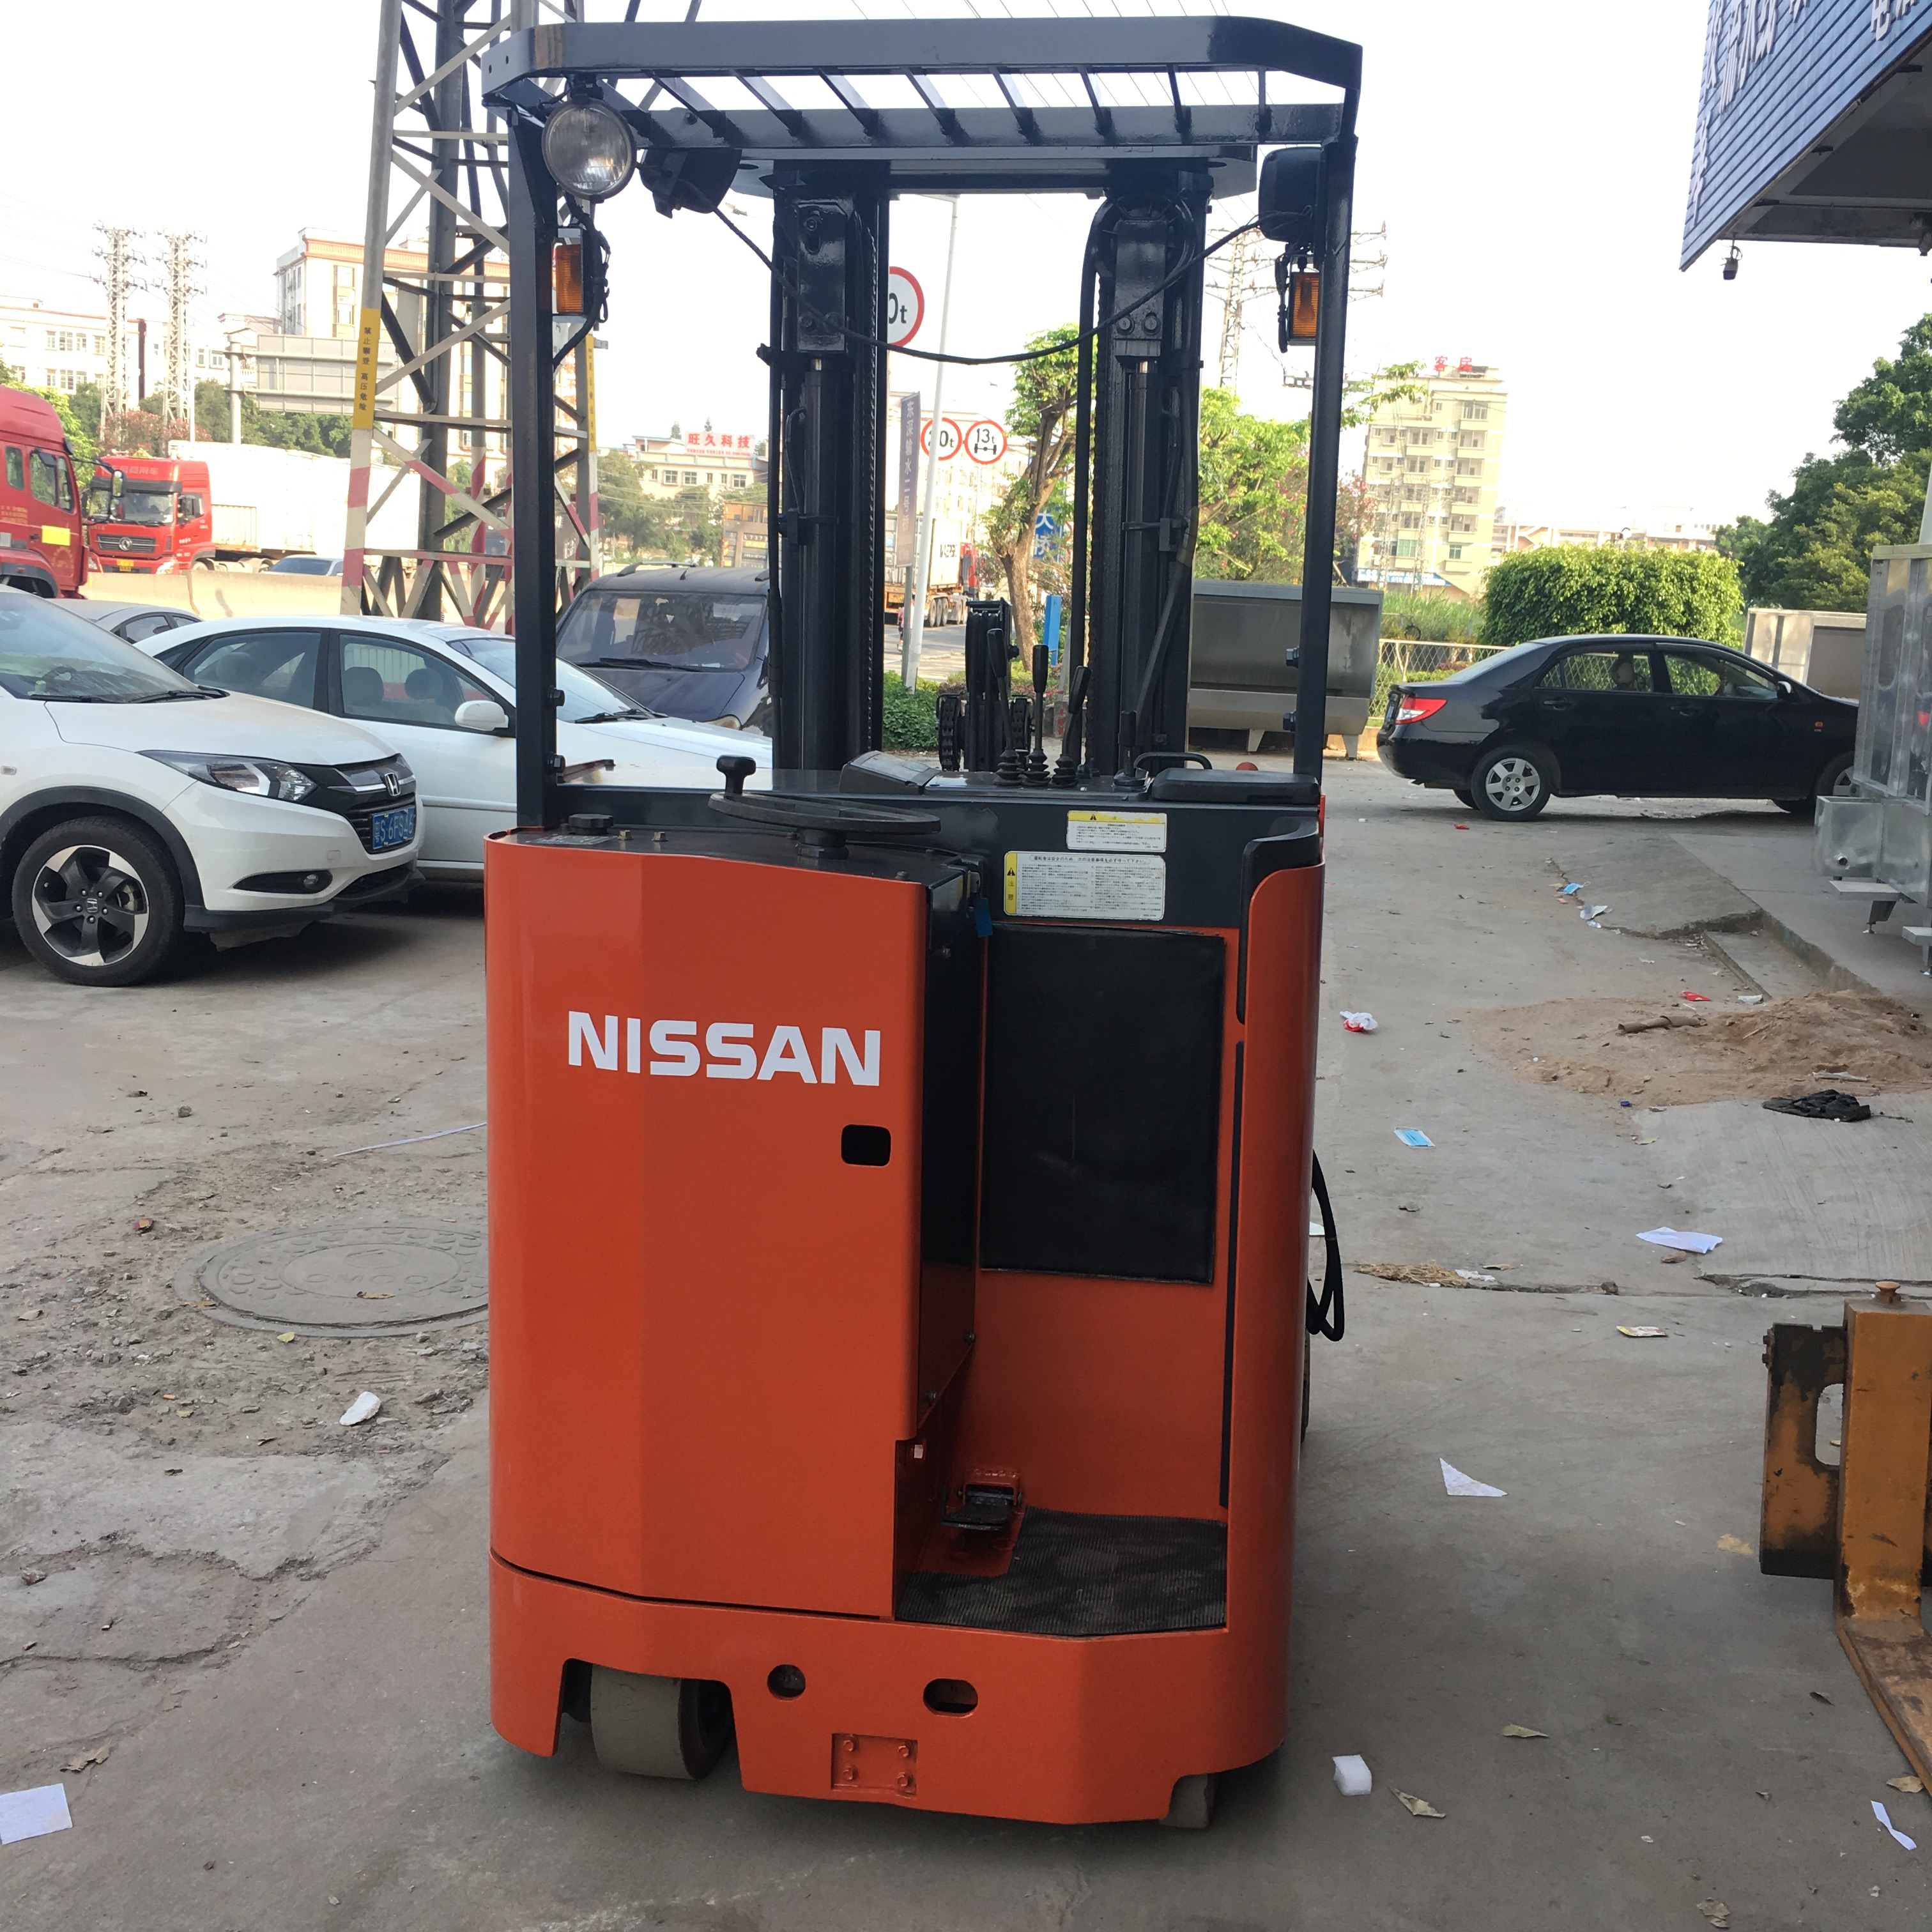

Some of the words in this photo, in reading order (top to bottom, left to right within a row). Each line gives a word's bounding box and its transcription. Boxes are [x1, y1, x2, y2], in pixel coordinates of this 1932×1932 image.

[359, 372, 369, 411] 高压危险
[687, 433, 751, 449] 旺久科技
[976, 427, 995, 444] 13t
[568, 1010, 882, 1087] NISSAN
